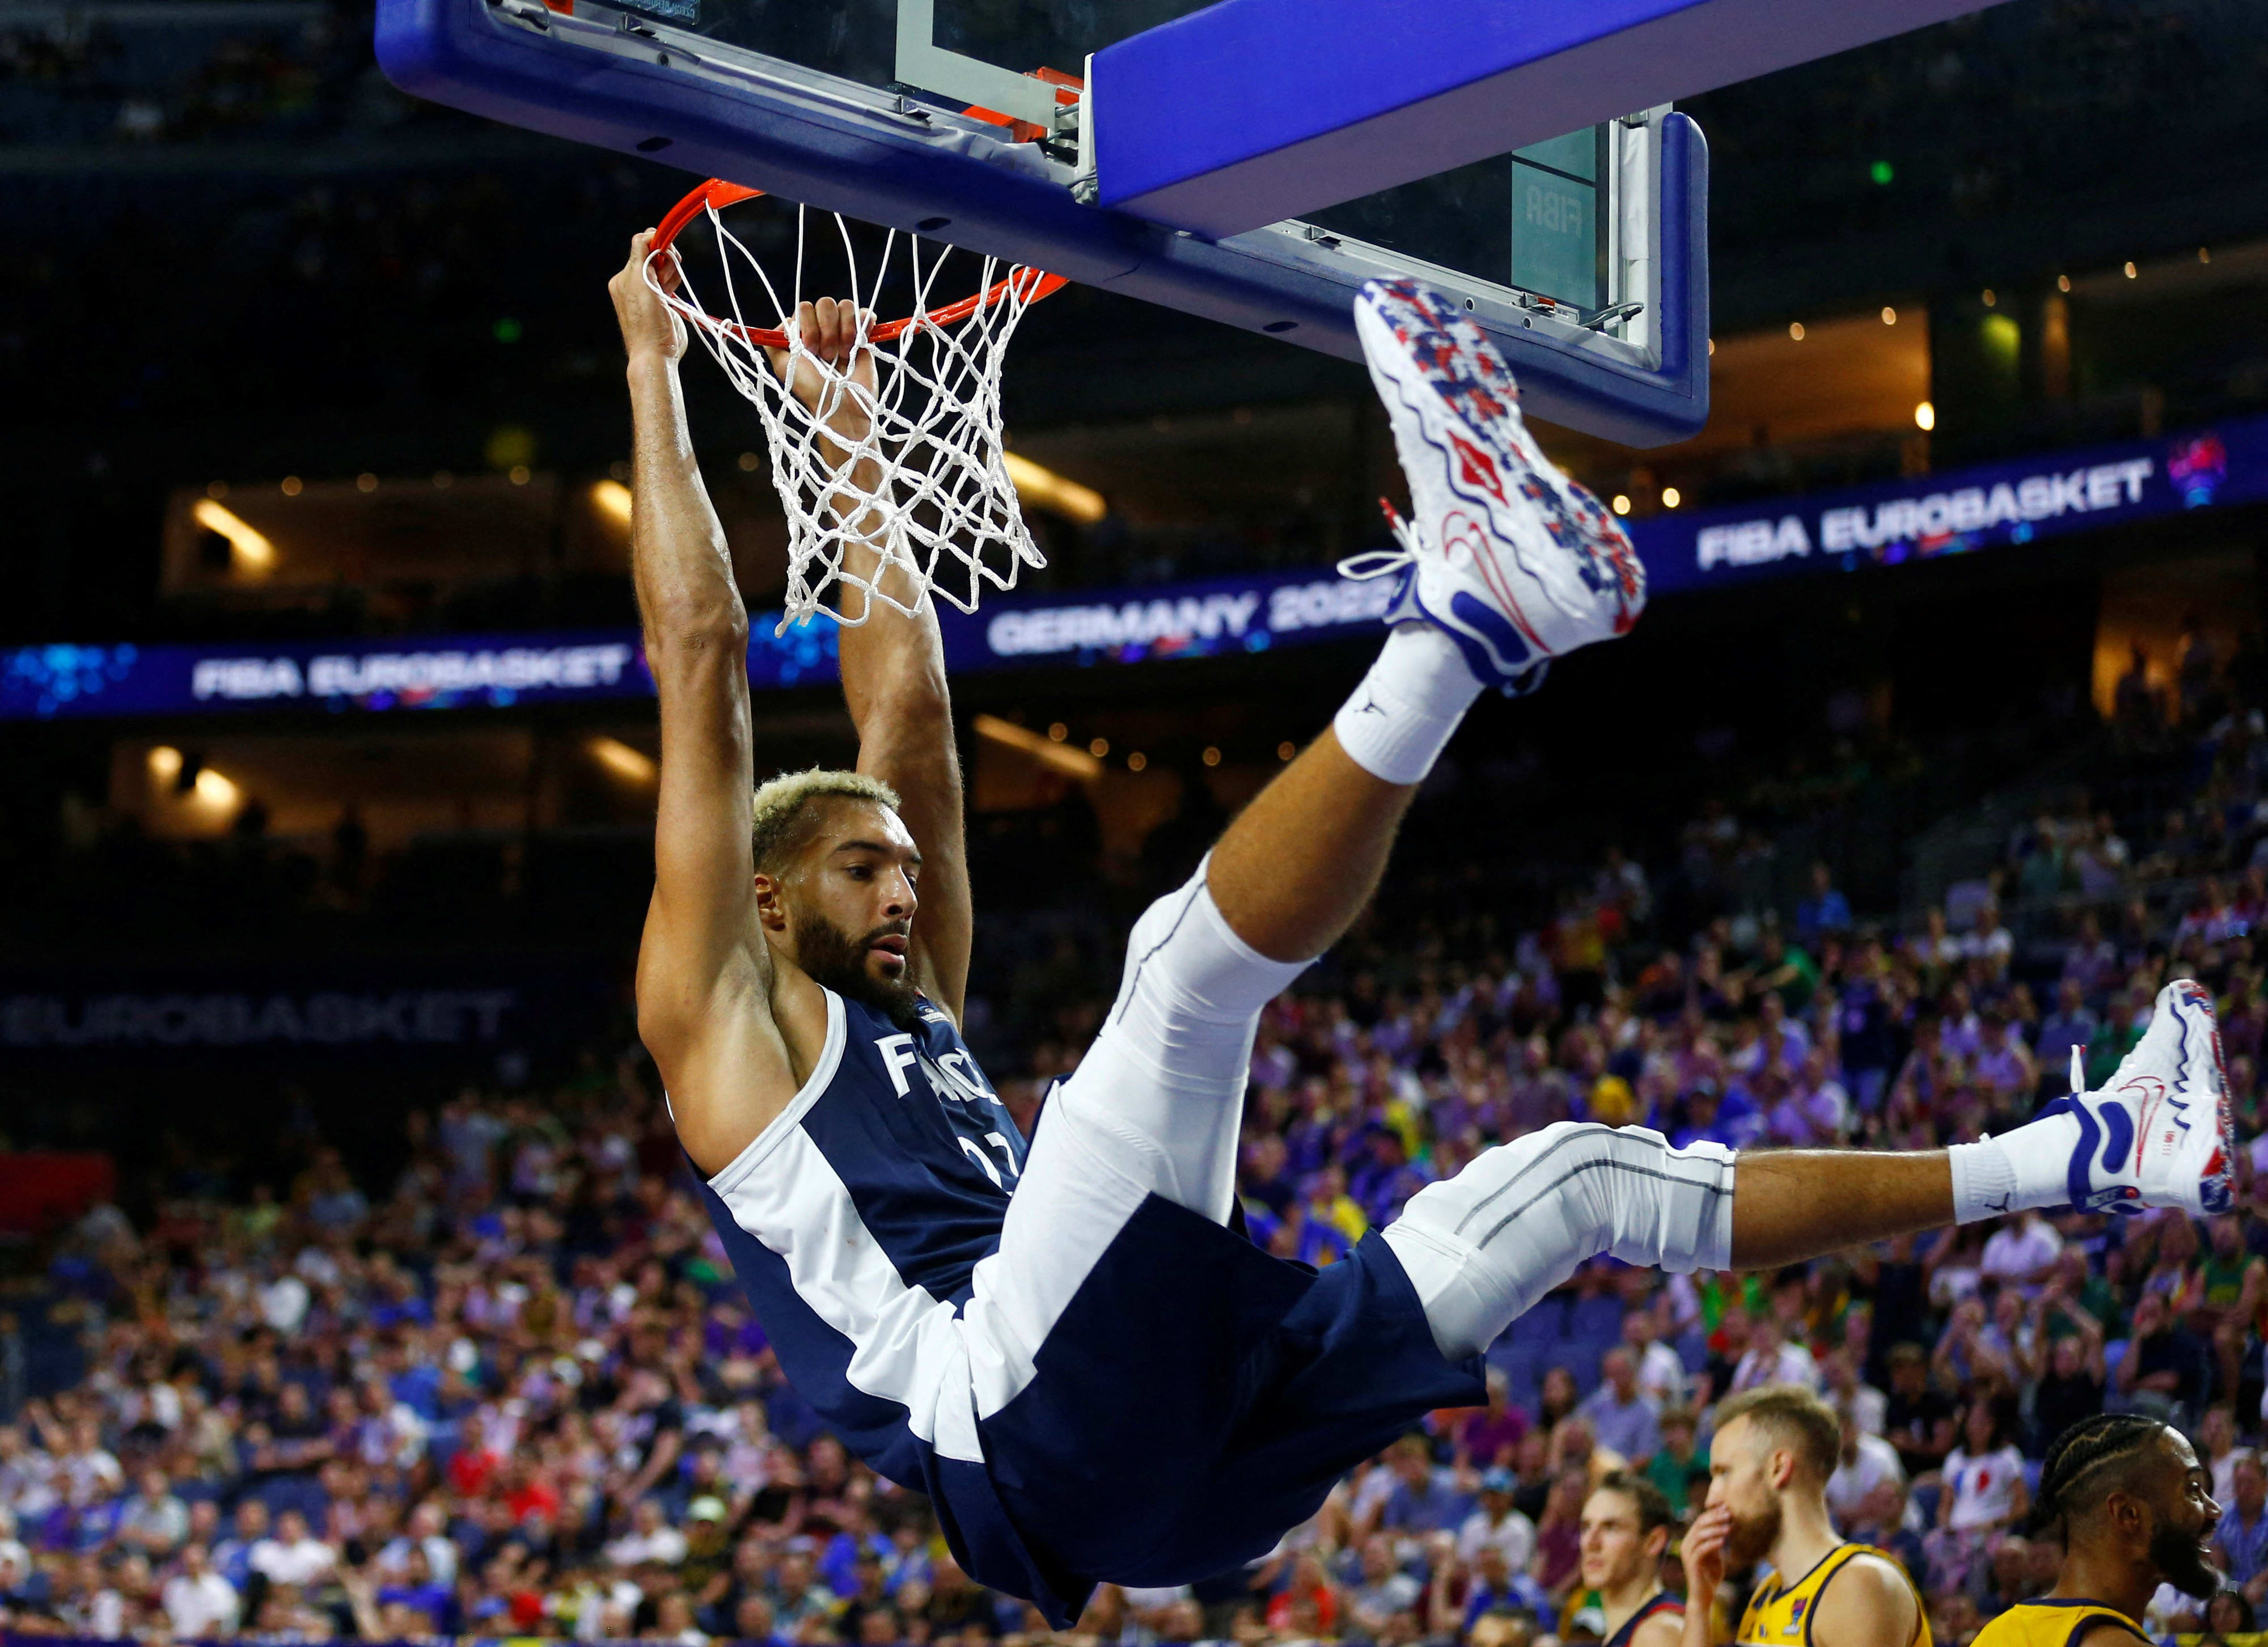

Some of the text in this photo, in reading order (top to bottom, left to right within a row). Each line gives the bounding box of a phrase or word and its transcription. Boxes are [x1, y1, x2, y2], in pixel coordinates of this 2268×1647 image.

[1698, 458, 2153, 569] FIBA EUROBASKET
[988, 591, 1259, 656] GERMANY
[193, 644, 631, 699] FIBA EUROBASKET
[1, 992, 514, 1044] EUROBASKET
[874, 1033, 1004, 1106] FAC
